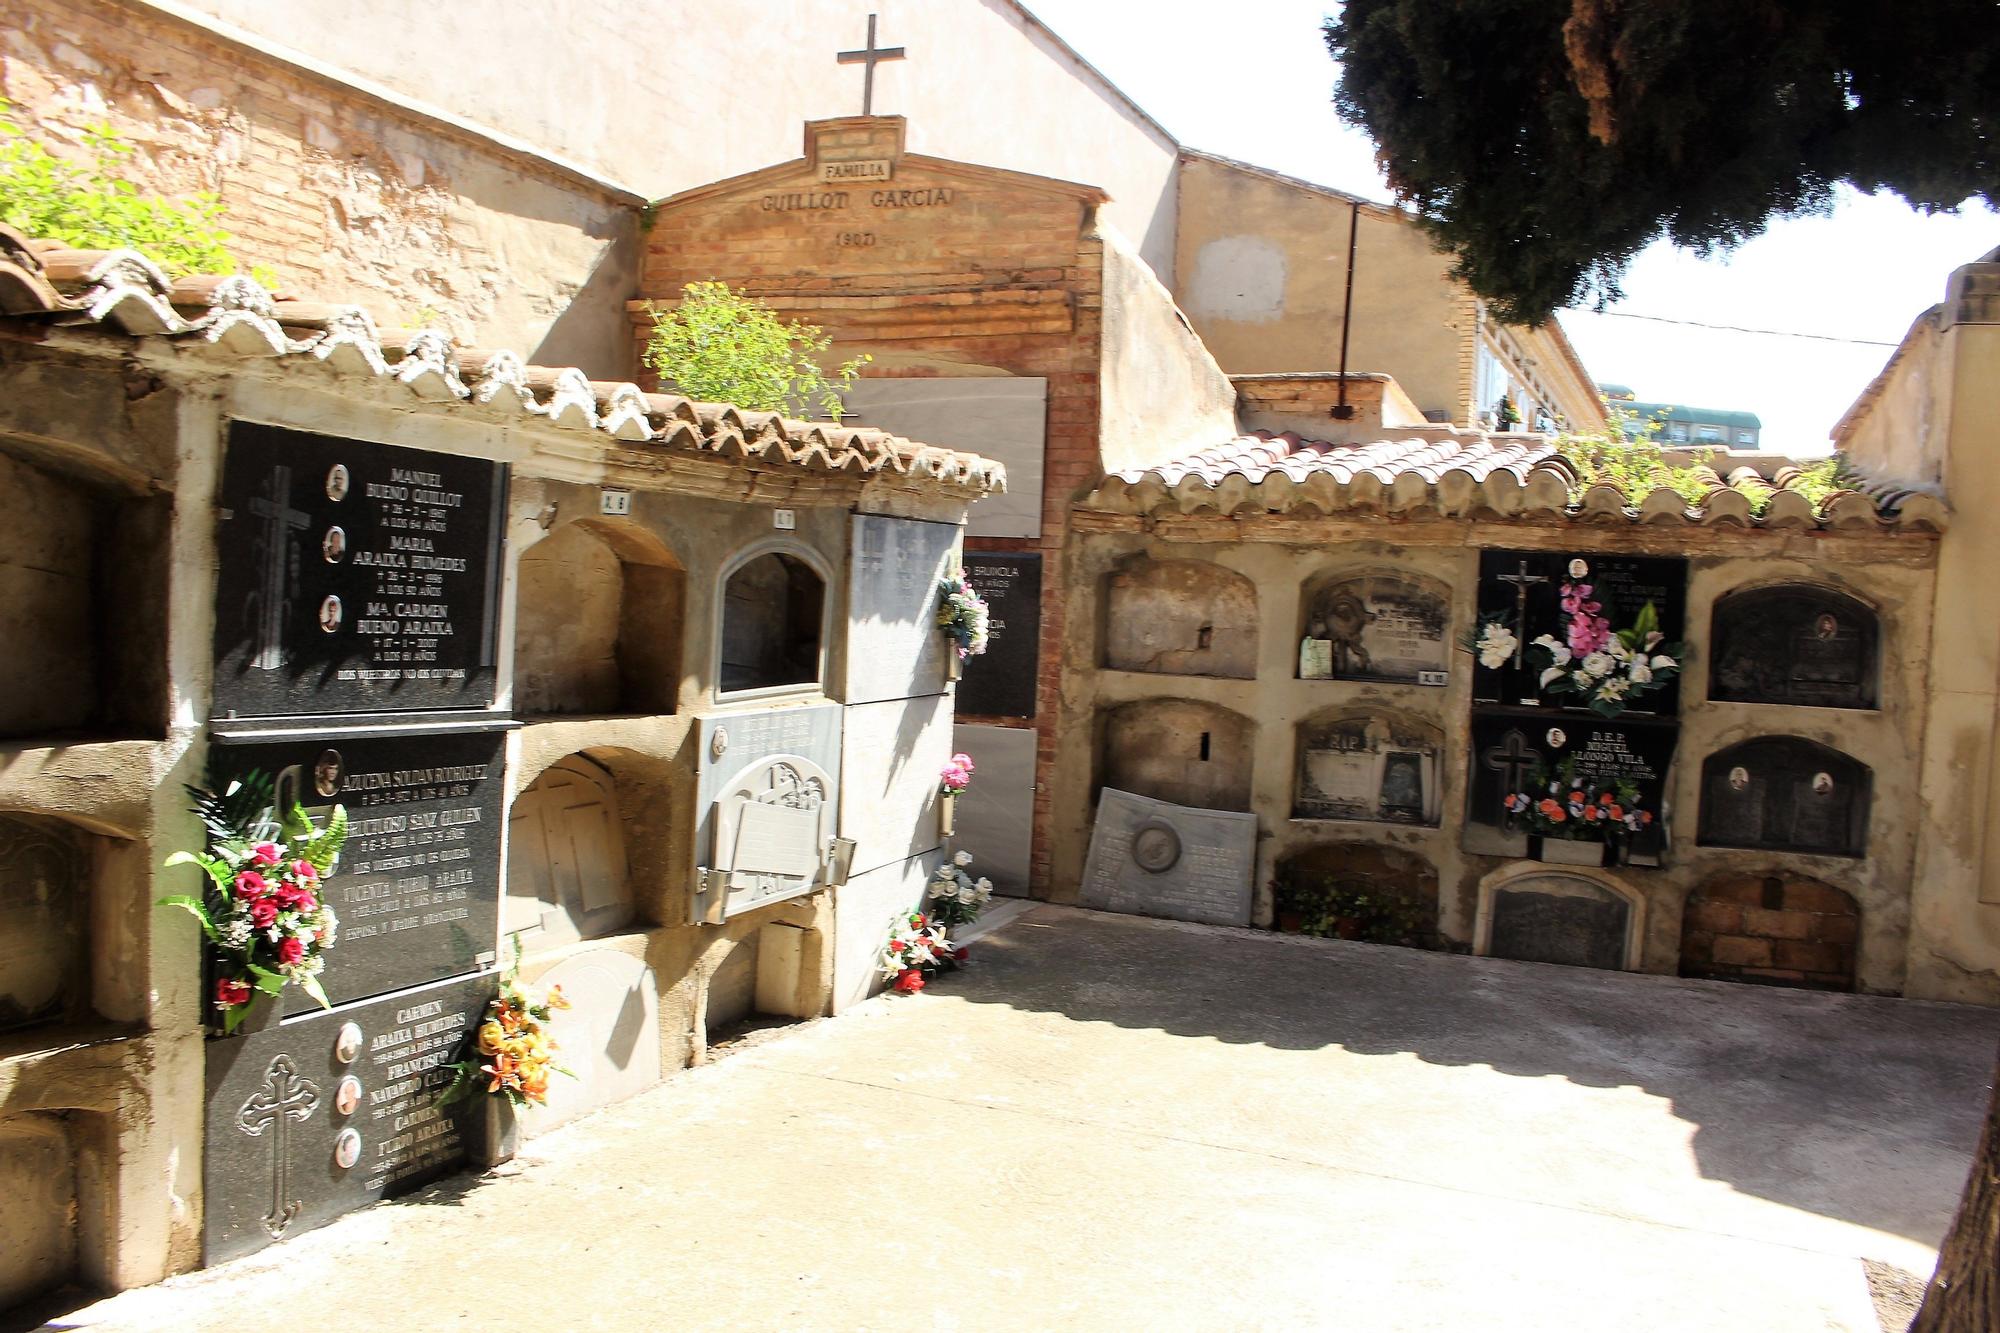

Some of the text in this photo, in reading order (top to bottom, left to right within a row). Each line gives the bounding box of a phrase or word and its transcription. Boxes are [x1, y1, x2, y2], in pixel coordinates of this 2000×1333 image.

[825, 163, 885, 178] FAMILIA
[761, 187, 949, 212] GUILLOT GARCIA
[390, 468, 442, 488] MANUEL
[366, 482, 409, 501] BUENO
[390, 535, 434, 552] MARIA
[394, 603, 449, 618] CARMEN
[356, 619, 399, 635] BUENO
